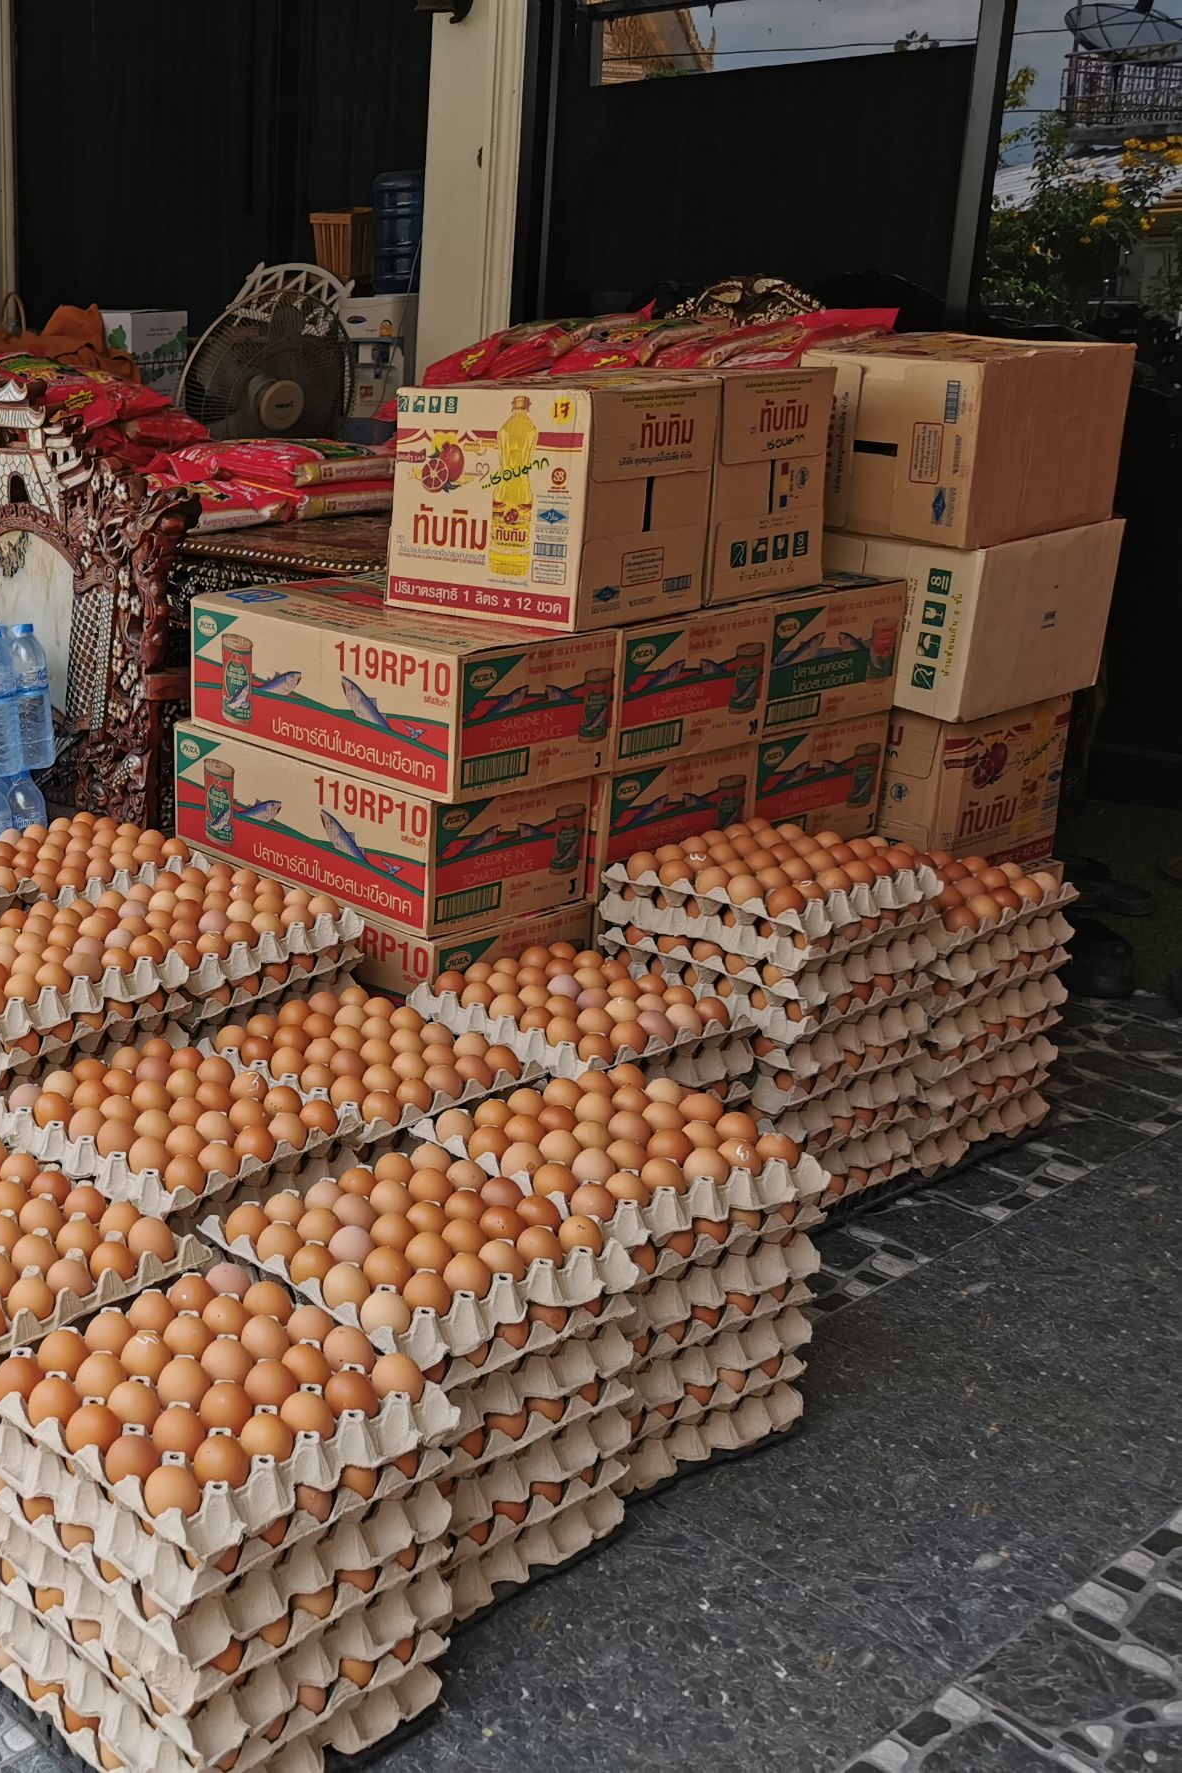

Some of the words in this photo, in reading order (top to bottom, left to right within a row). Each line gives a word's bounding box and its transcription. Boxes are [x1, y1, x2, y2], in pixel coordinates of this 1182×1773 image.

[640, 412, 695, 449] ทับทิม
[759, 398, 809, 433] ทับทิม
[412, 503, 488, 551] ทับทิม
[495, 525, 527, 543] ทับทิม
[394, 579, 458, 604] ปริมาตรสุทธิ
[463, 590, 470, 602] 1
[475, 590, 499, 606] ลิตร
[516, 597, 532, 611] 12
[536, 600, 563, 615] ขวด
[334, 641, 452, 697] 119RP10
[490, 731, 531, 749] TOMATO
[533, 724, 563, 742] SAUCE
[501, 715, 541, 732] SARDINE
[543, 711, 553, 723] IN
[271, 715, 437, 782] ปลาซาร์ดีนในซอสมะเขือเทศ
[314, 775, 428, 839] 119RP10
[958, 794, 1017, 838] ทับทิม
[462, 867, 503, 885] TOMATO
[505, 861, 535, 877] SAUCE
[473, 851, 513, 869] SARDINE
[516, 847, 526, 858] IN
[252, 841, 413, 917] ปลาซาร์ดีนในซอสมะเขือเทศ
[355, 926, 430, 980] RP10
